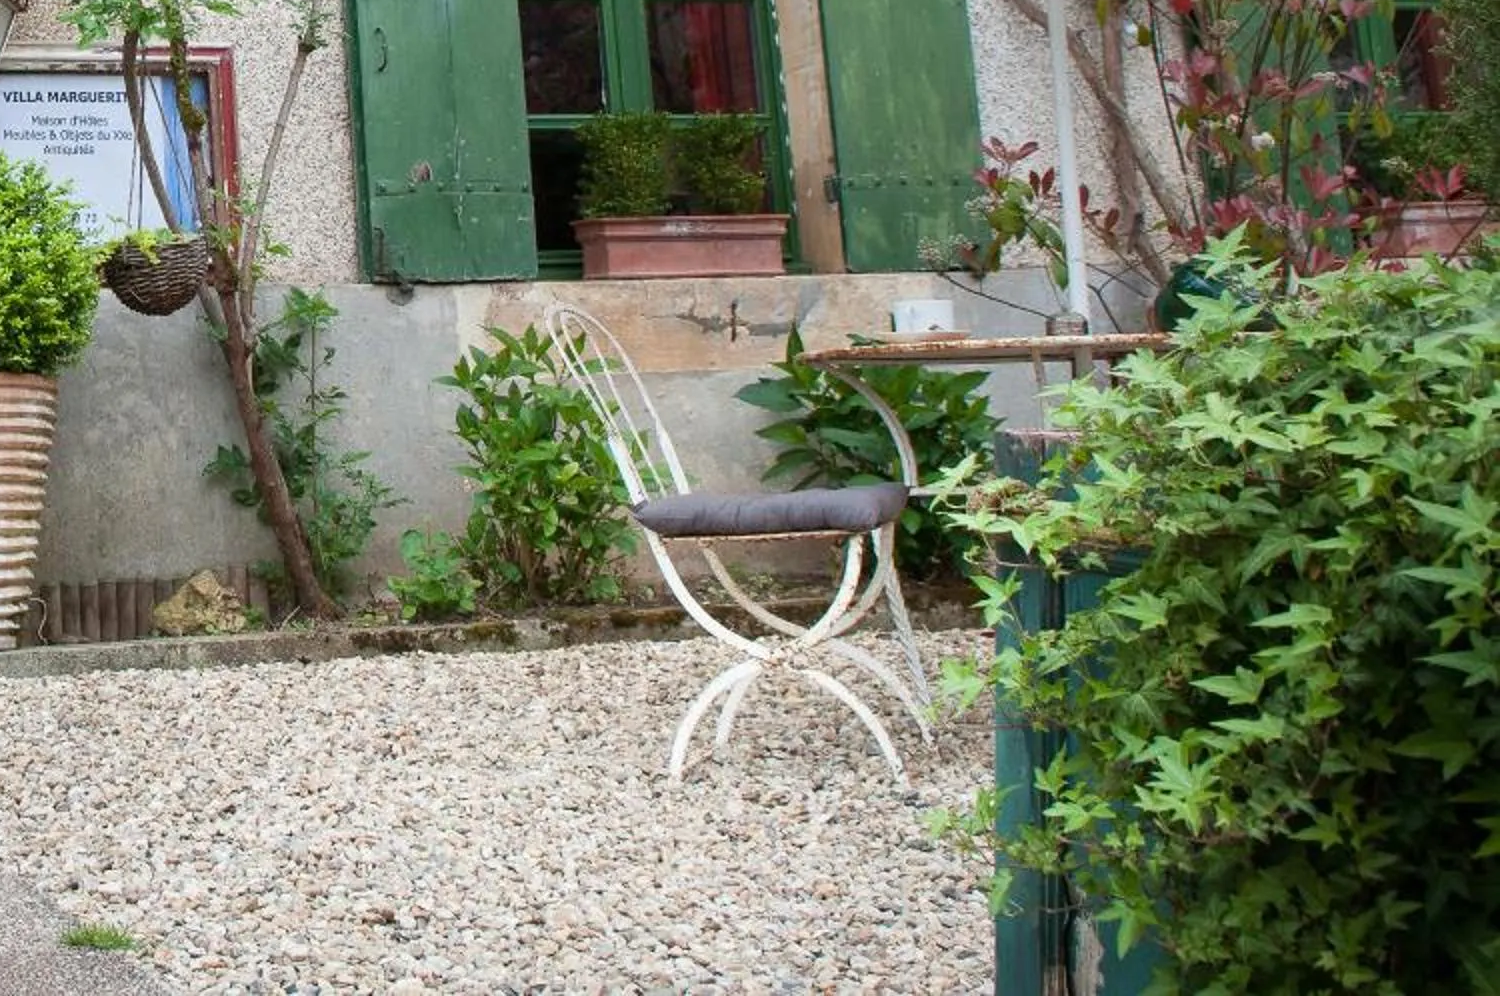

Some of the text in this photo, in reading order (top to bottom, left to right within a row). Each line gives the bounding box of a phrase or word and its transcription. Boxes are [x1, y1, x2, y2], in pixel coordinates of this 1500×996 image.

[3, 91, 129, 103] VILLA MARGUERIT
[31, 115, 67, 125] Maison
[3, 129, 46, 141] Meubles
[60, 129, 94, 142] Objets
[98, 129, 110, 141] du
